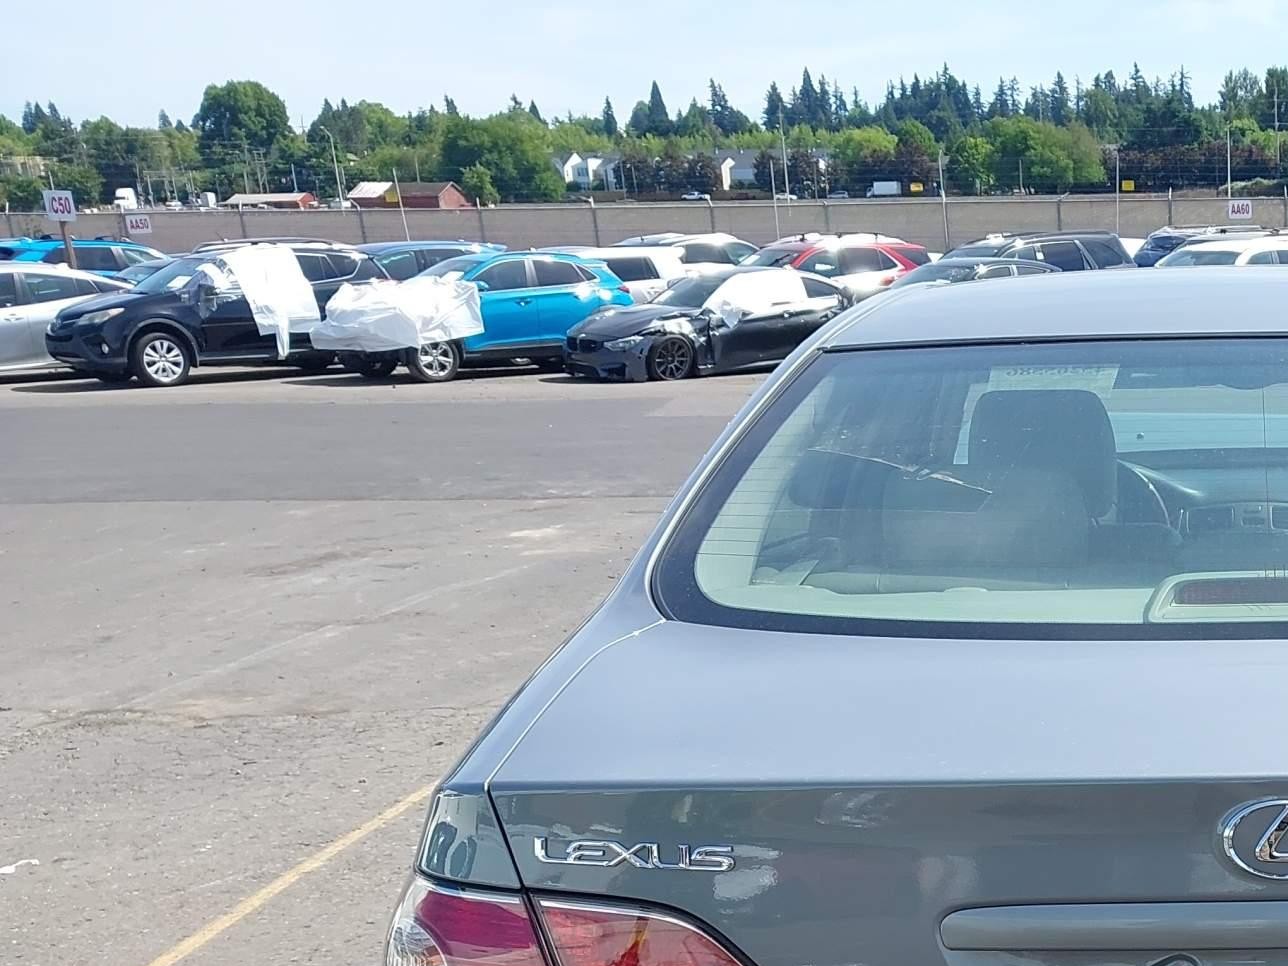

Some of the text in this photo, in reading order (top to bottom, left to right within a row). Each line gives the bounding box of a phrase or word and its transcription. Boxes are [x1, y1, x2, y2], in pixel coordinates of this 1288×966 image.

[50, 196, 72, 215] C50
[1231, 203, 1250, 215] AA60
[129, 218, 149, 230] AA50
[534, 837, 736, 872] LEXUS
